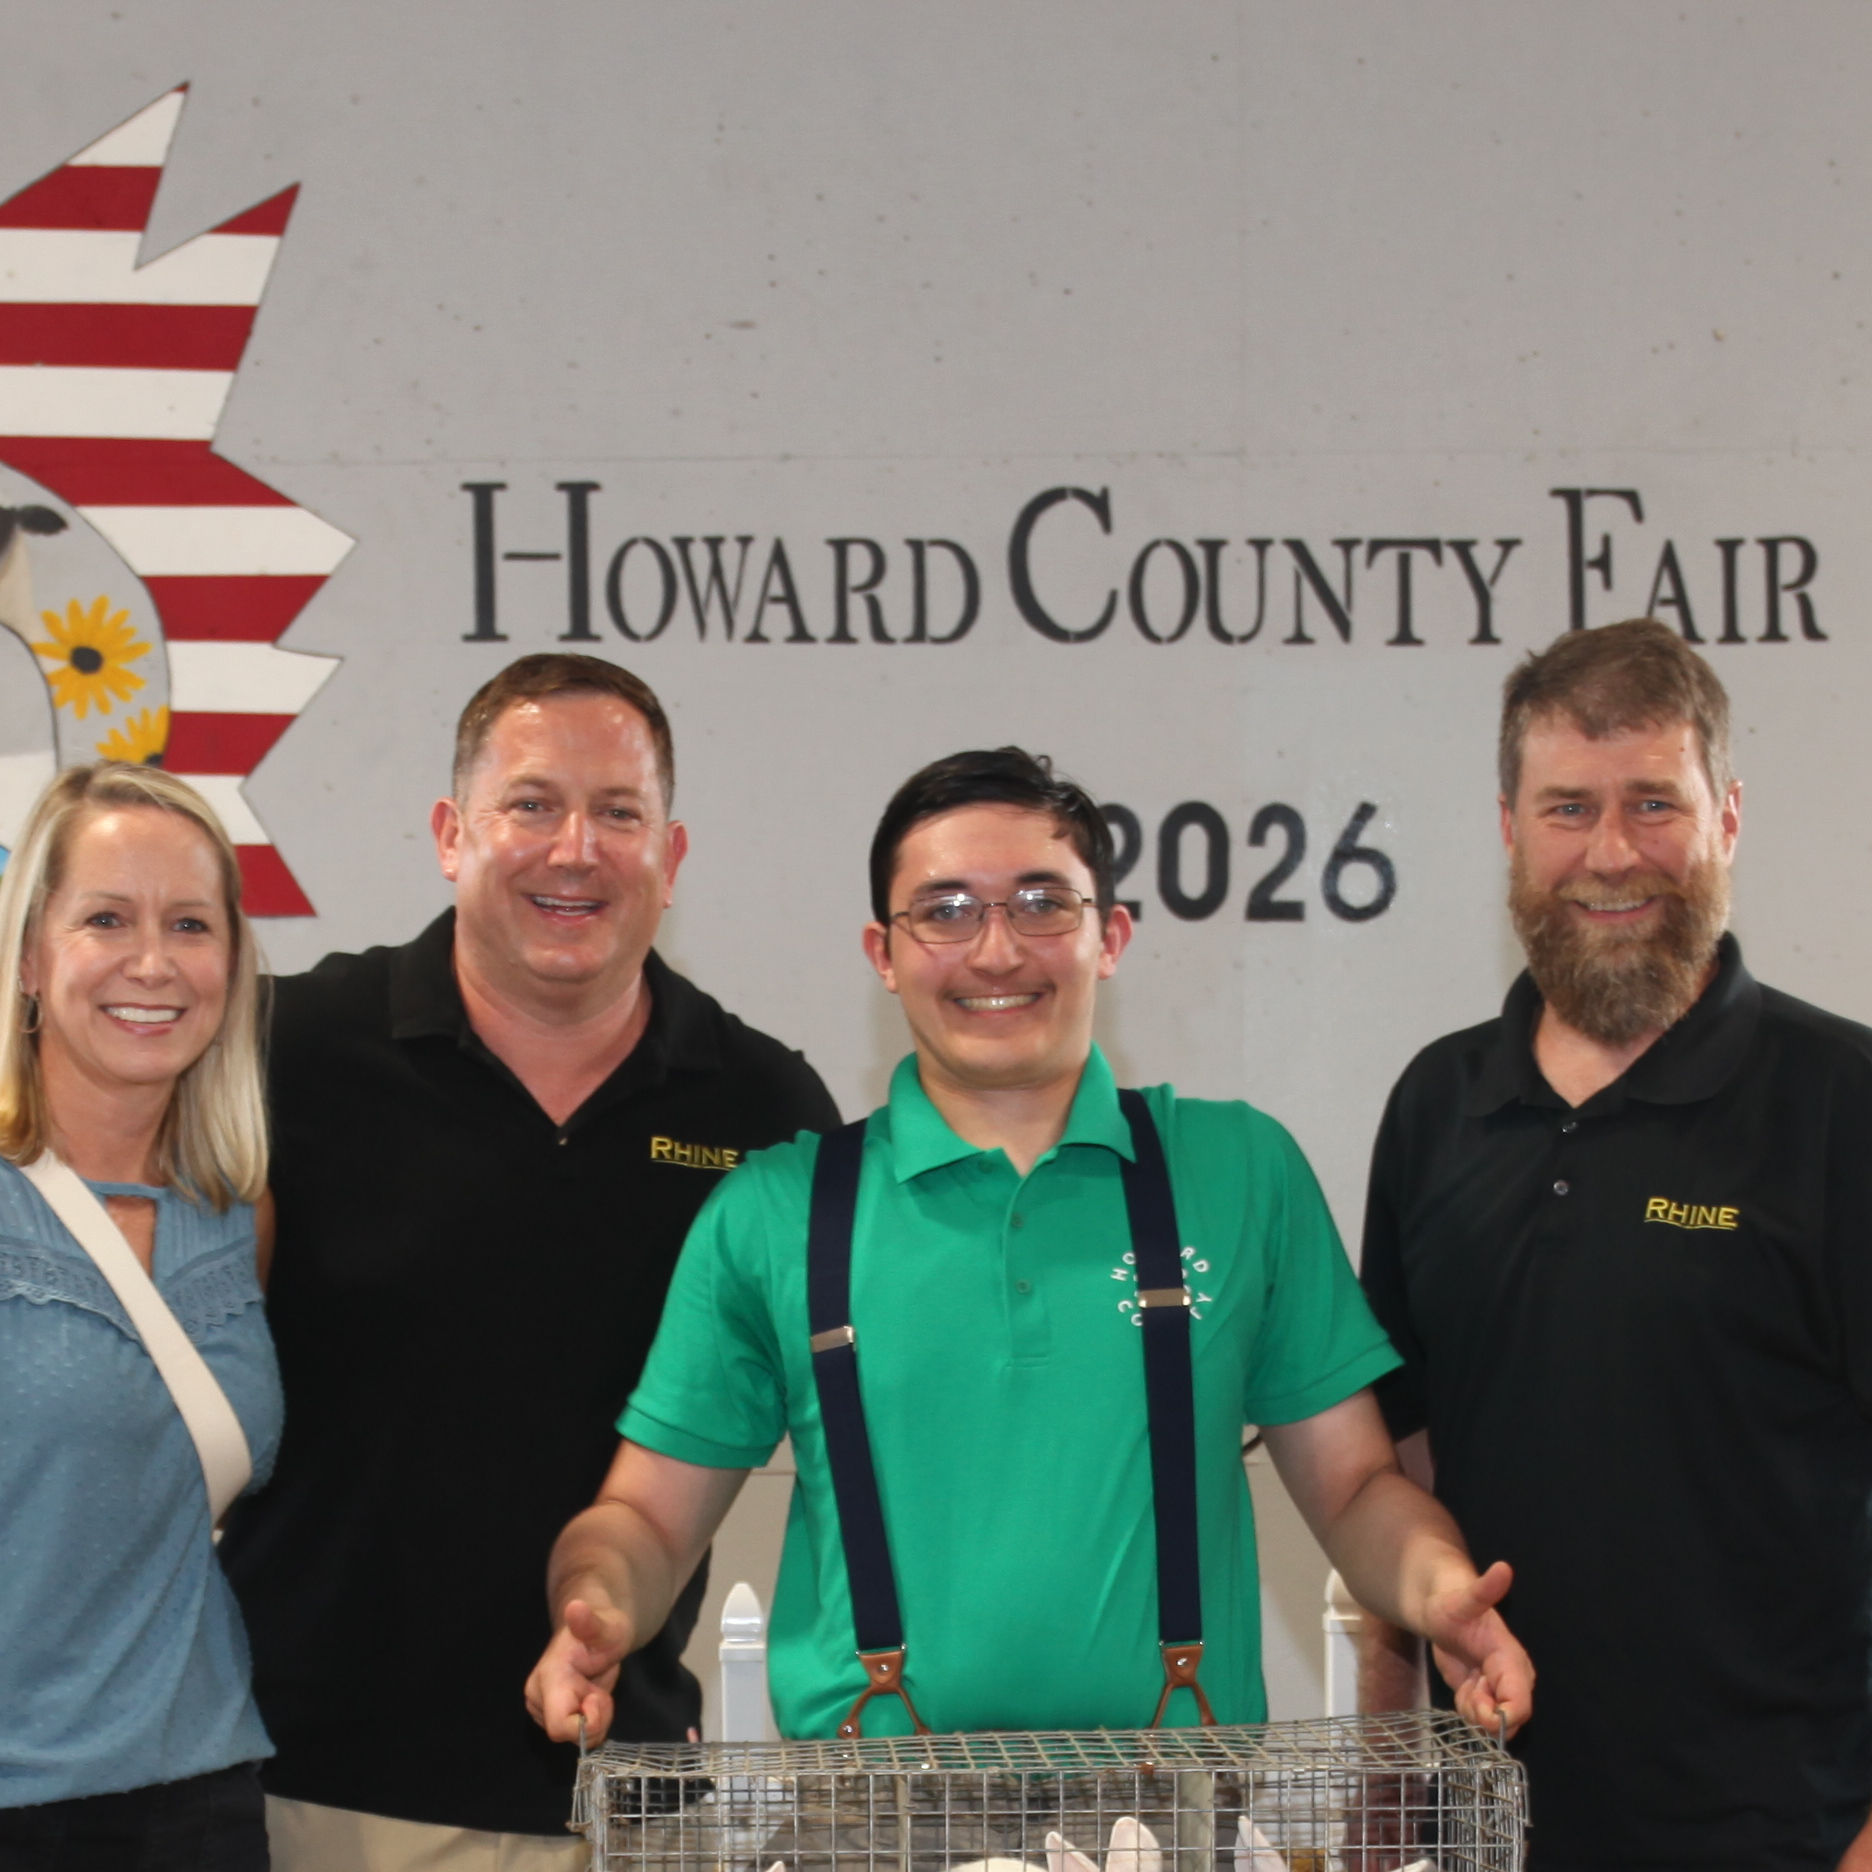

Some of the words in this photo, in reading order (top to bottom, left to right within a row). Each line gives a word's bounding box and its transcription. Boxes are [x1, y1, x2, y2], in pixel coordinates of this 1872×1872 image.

[461, 481, 981, 643] HOWARD
[1008, 485, 1523, 645] COUNTY
[1548, 487, 1829, 645] FAIR
[650, 1136, 739, 1169] RHINE
[1645, 1196, 1740, 1228] RHINE
